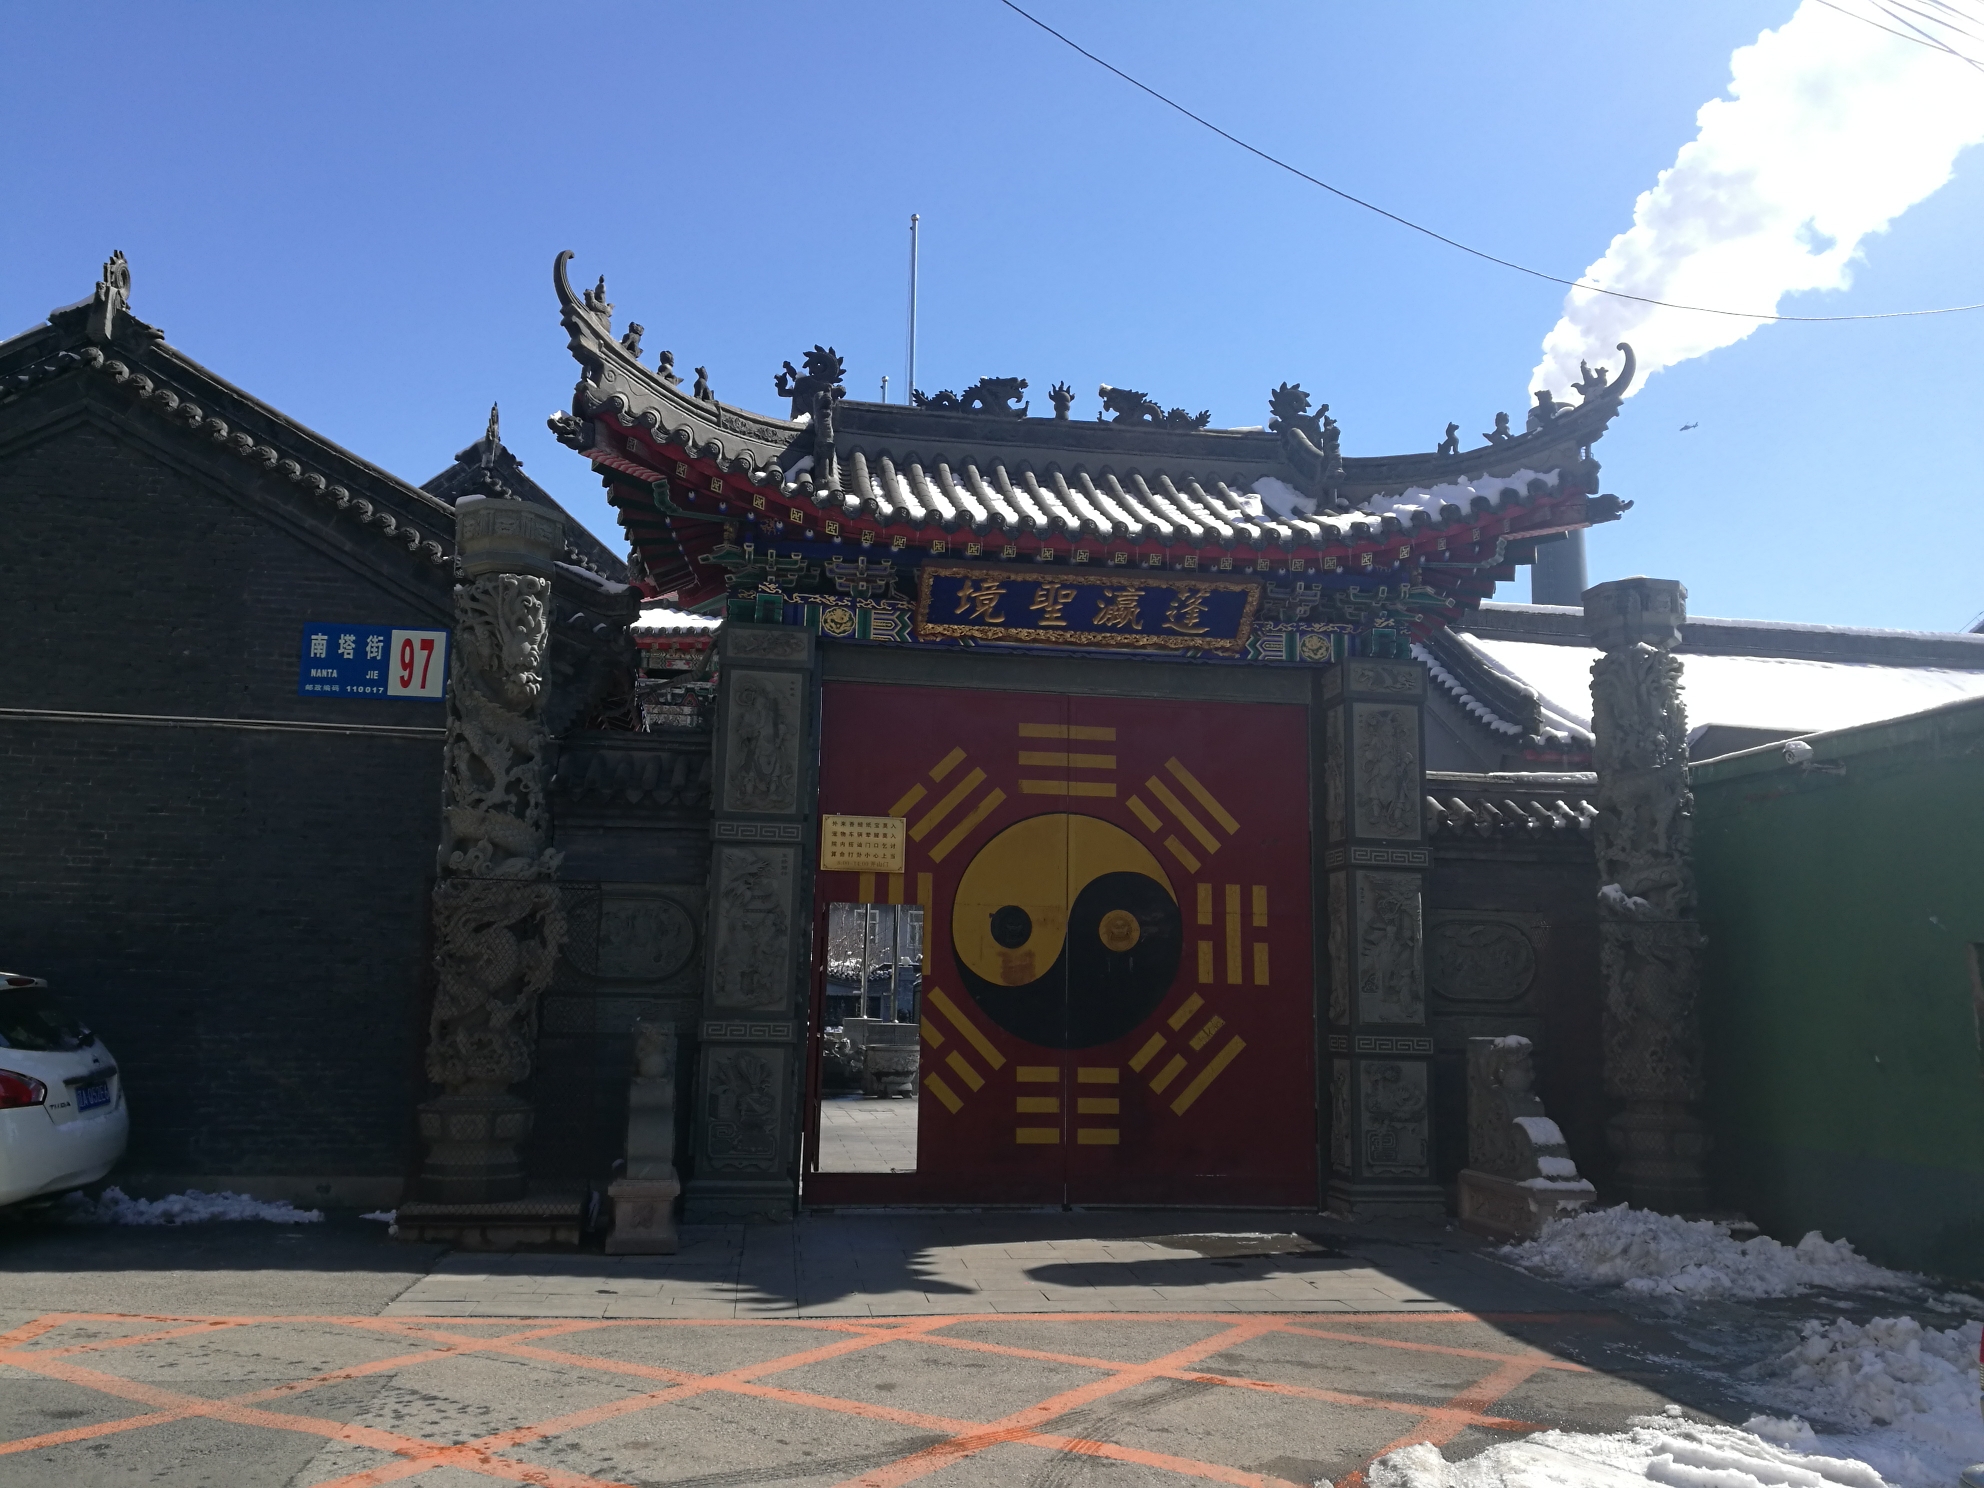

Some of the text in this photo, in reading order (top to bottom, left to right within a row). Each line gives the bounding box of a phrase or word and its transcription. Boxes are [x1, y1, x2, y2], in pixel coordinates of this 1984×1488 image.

[310, 632, 384, 661] 南塔街
[310, 668, 379, 679] NANTA JIE
[399, 637, 435, 690] 97
[304, 684, 384, 694] 邮政编码 110017
